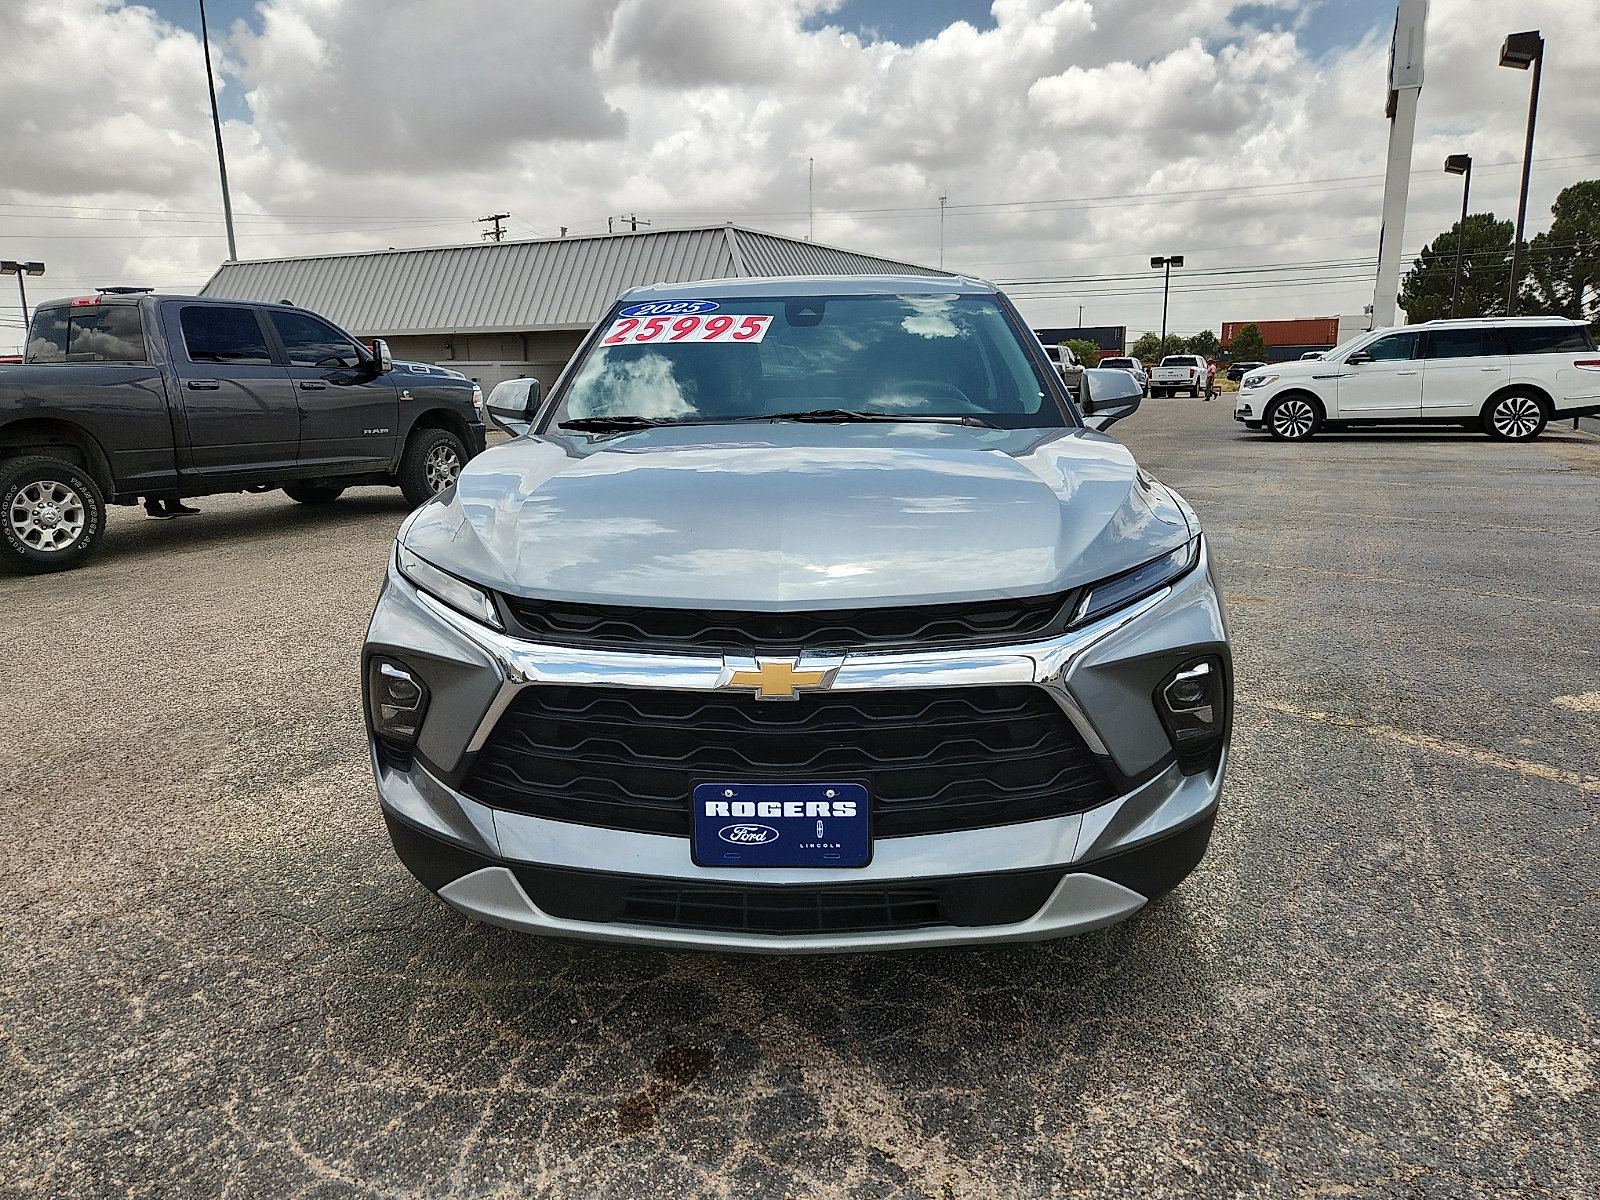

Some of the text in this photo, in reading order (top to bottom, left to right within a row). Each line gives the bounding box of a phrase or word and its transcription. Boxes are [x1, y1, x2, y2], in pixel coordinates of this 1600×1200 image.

[633, 302, 702, 315] 2025
[604, 316, 771, 344] 25995
[705, 801, 857, 818] ROGERS
[729, 826, 767, 842] Ford
